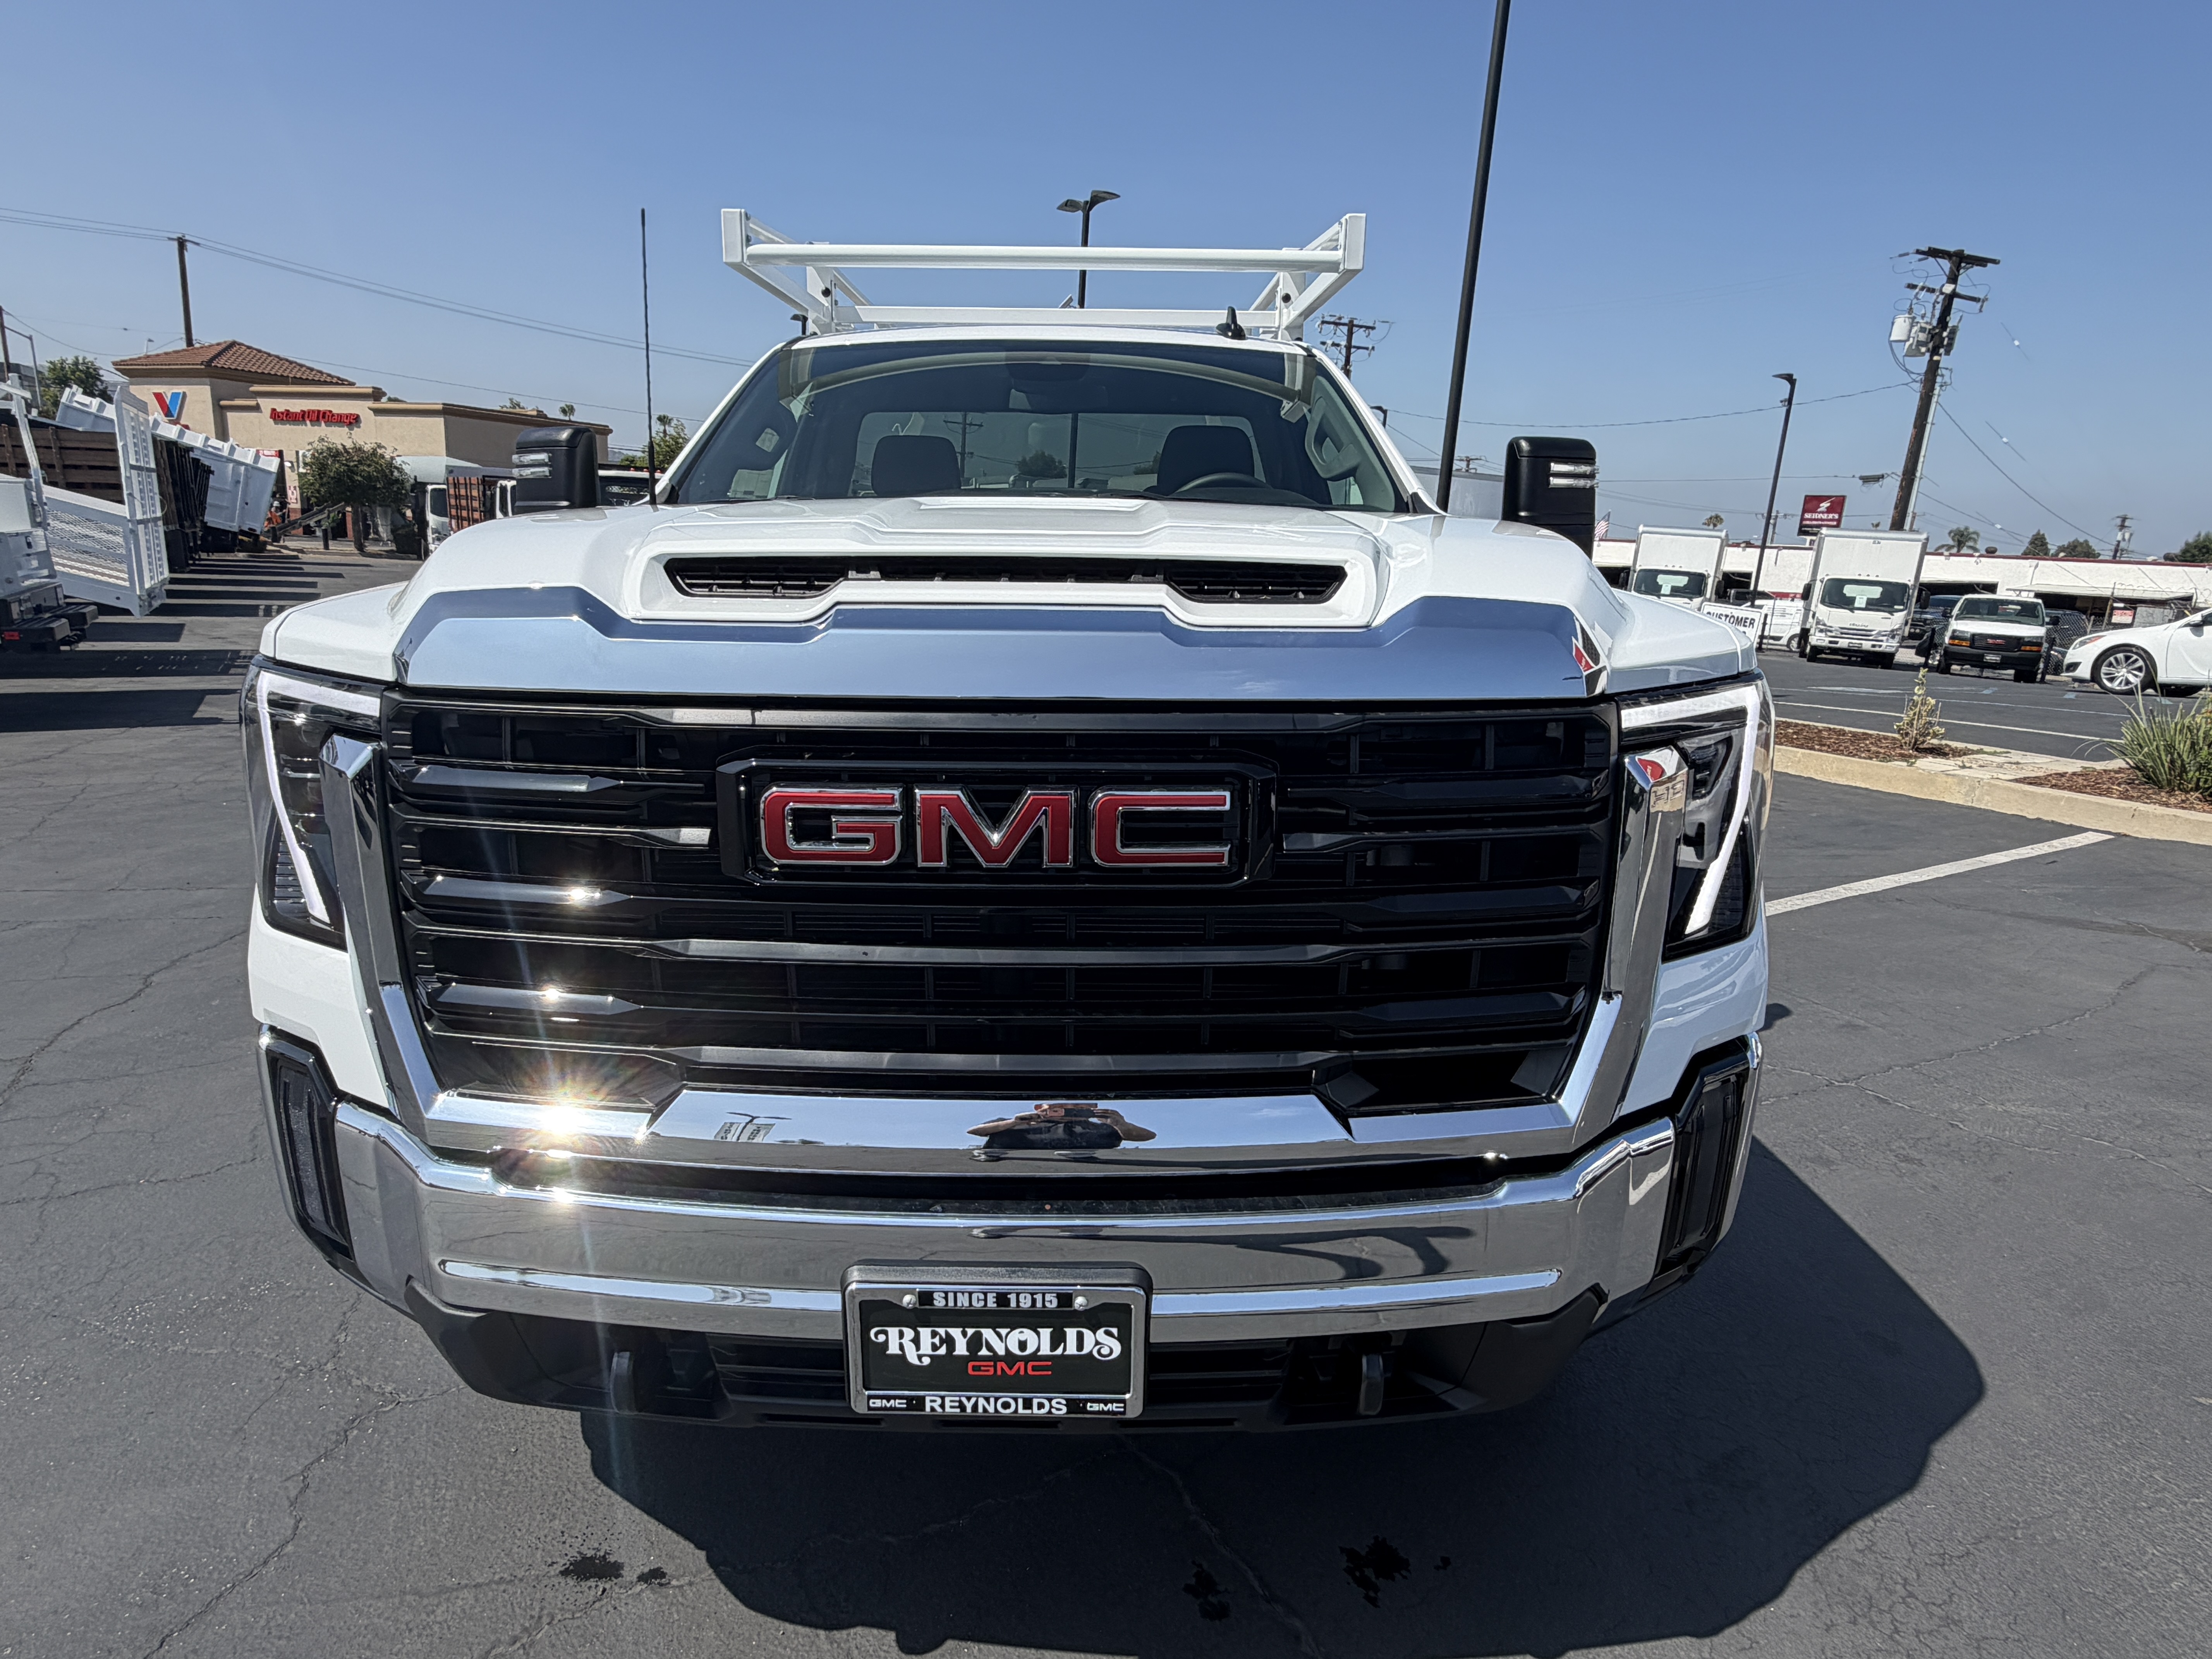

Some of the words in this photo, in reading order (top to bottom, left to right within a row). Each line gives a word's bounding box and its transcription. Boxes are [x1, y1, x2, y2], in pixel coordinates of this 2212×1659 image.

[270, 408, 305, 421] Instant
[305, 409, 319, 421] Oil
[319, 409, 360, 426] Change
[760, 785, 1231, 868] GMC
[933, 1292, 997, 1307] SINCE
[1007, 1293, 1058, 1308] 1915
[870, 1327, 1121, 1366] REYNOLDS
[968, 1361, 1052, 1376] GMC
[869, 1399, 907, 1408] GMC
[925, 1396, 1067, 1415] REYNOLDS
[1087, 1402, 1125, 1412] GMC
